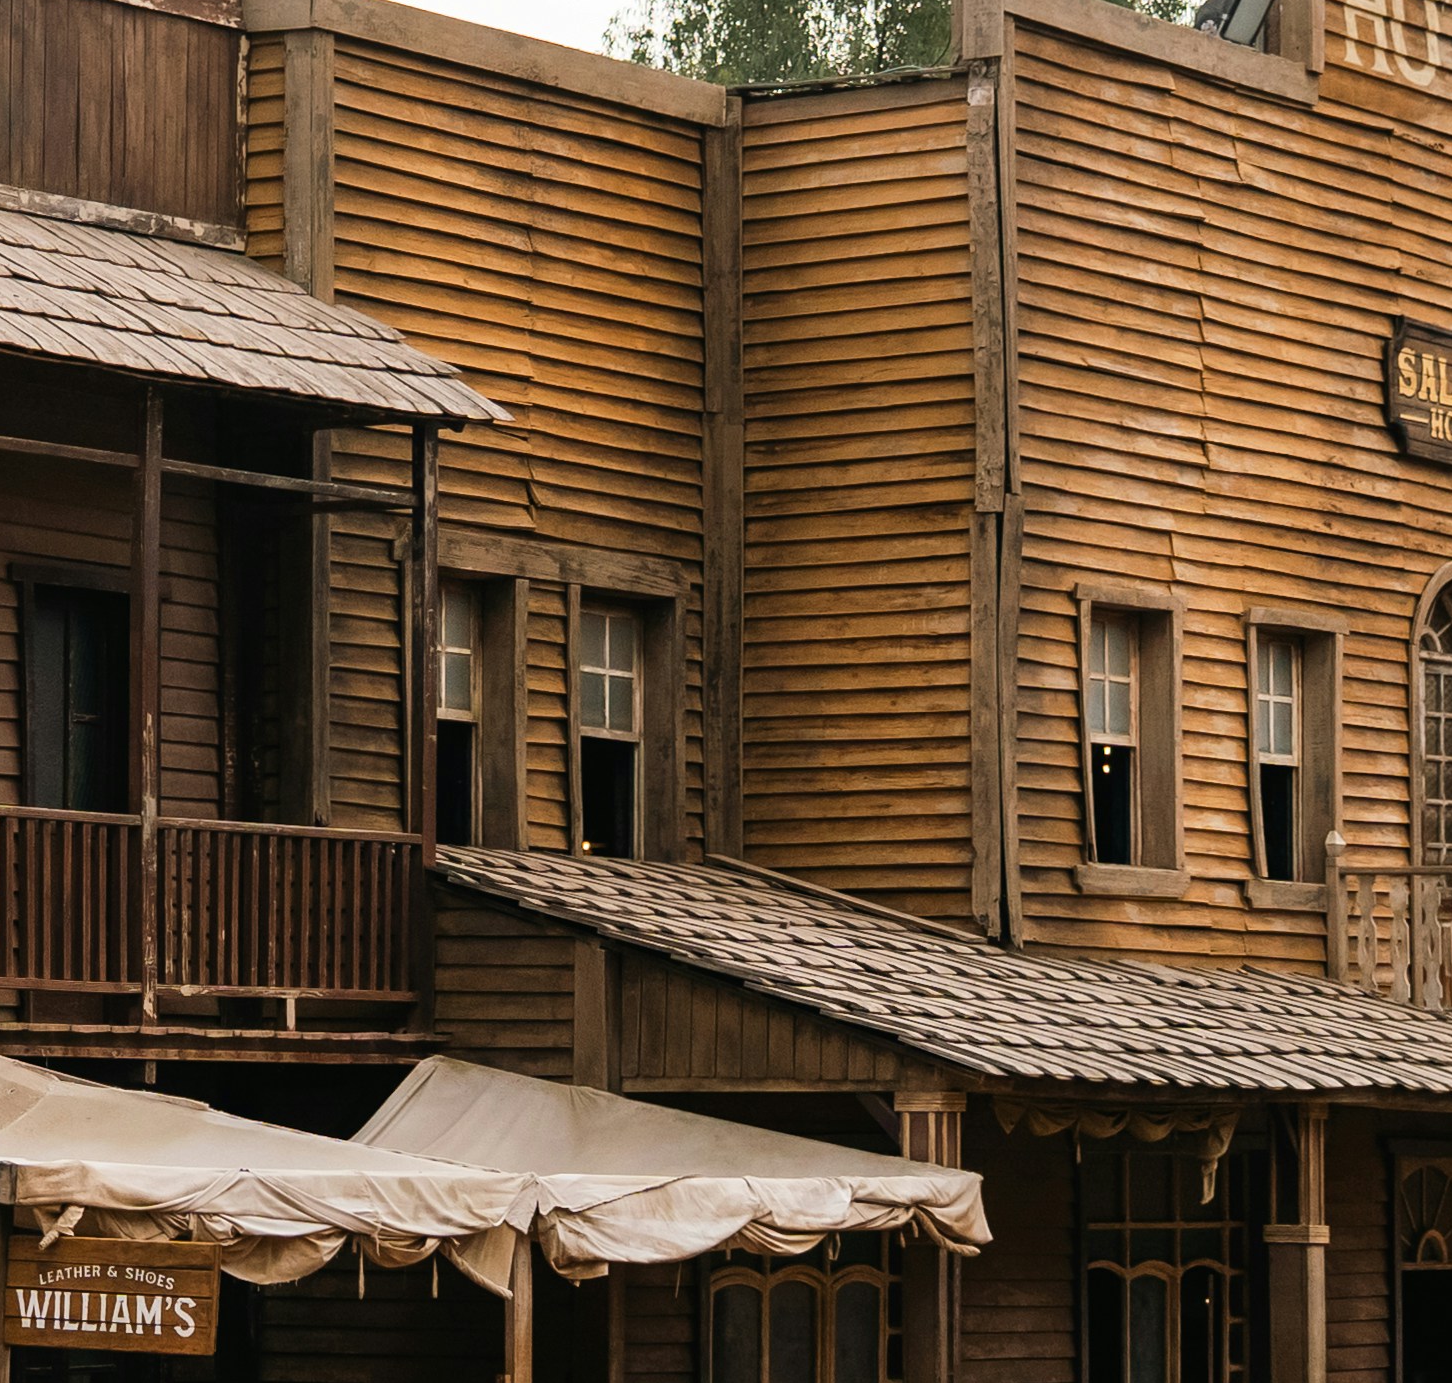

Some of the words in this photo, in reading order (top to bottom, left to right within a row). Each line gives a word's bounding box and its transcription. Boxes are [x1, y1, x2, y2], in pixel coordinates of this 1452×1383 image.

[38, 1264, 102, 1286] LEATHER
[107, 1265, 118, 1278] &
[125, 1267, 175, 1290] SHOES
[15, 1287, 197, 1338] WILLIAM'S
